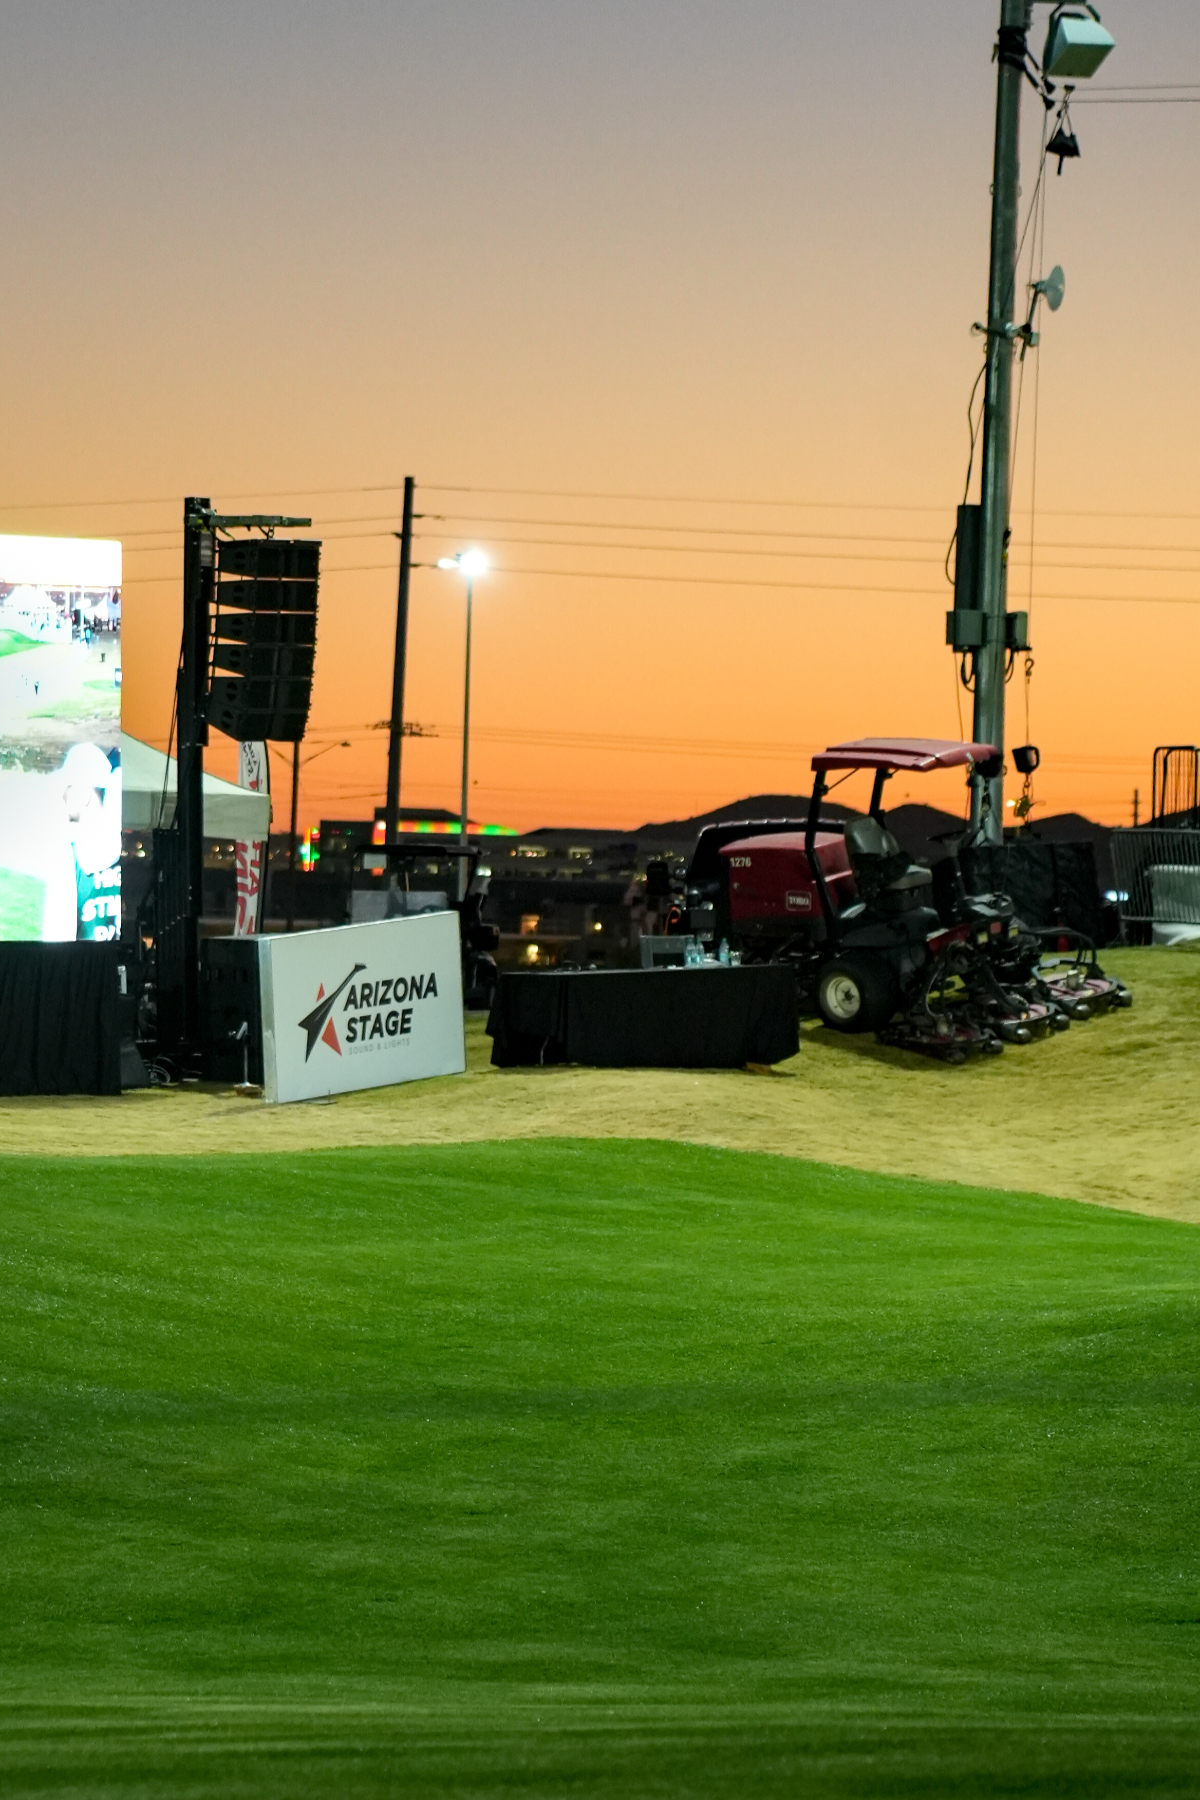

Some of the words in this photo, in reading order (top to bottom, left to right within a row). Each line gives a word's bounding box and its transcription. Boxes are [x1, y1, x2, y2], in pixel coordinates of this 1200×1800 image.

[343, 972, 438, 1012] ARIZONA
[345, 1008, 413, 1043] STAGE
[348, 1043, 375, 1055] SOUND
[384, 1037, 410, 1050] LIGHTS
